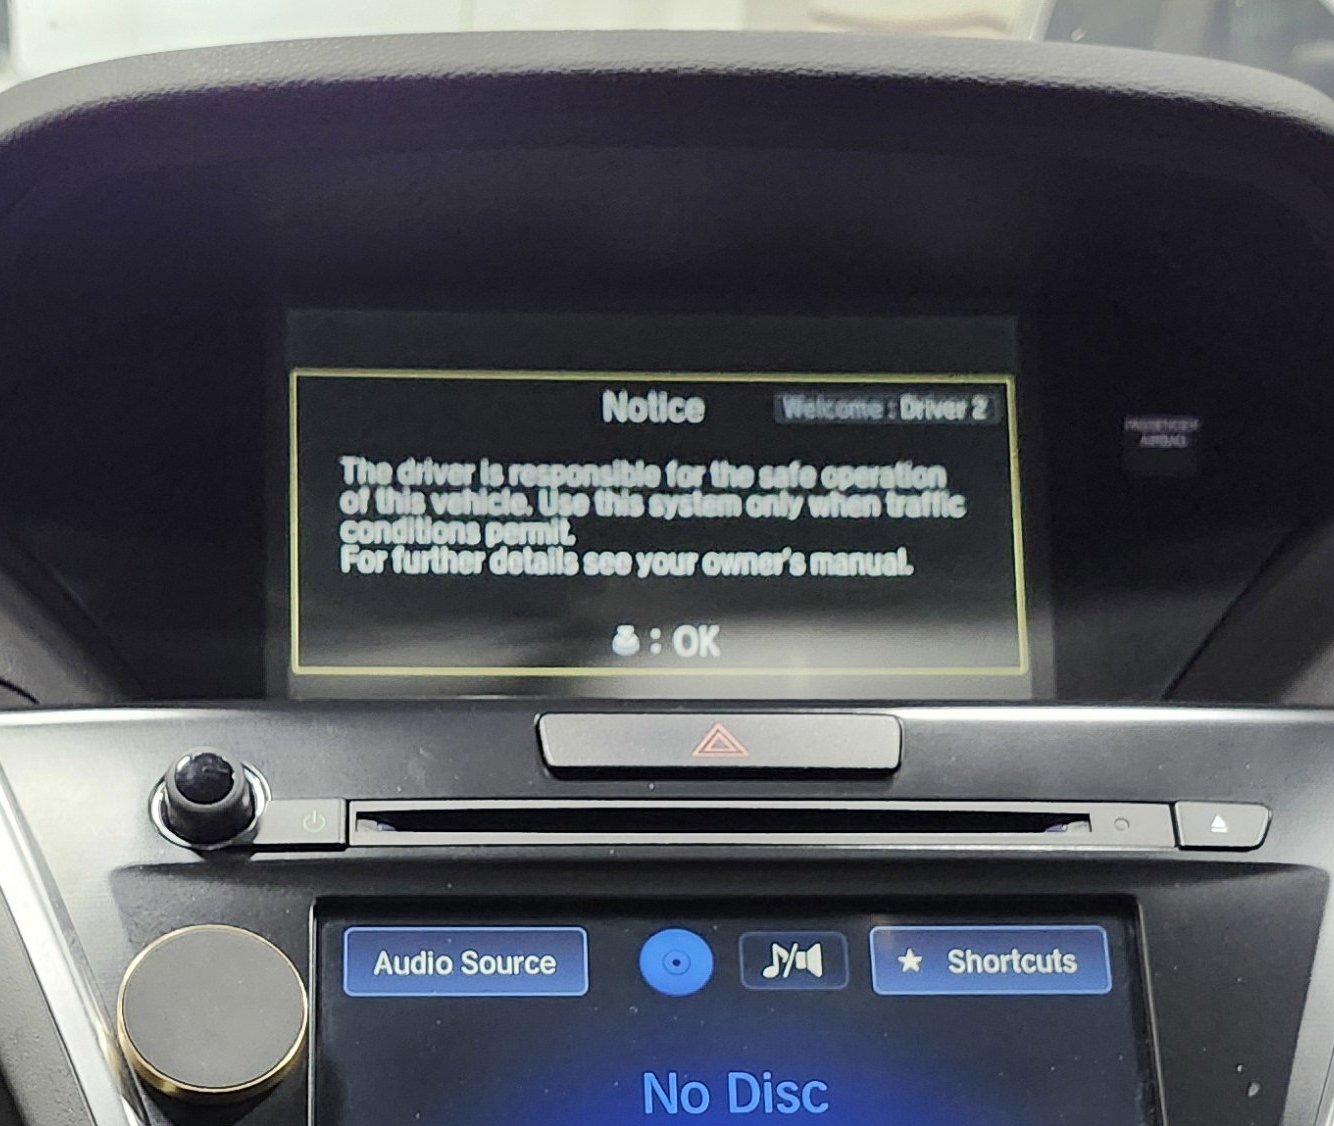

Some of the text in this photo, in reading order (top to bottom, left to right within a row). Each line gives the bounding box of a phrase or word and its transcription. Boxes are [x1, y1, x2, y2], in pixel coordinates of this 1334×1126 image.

[603, 389, 705, 423] Notice
[783, 394, 884, 420] Welcome
[900, 394, 967, 420] Driver
[972, 395, 988, 420] 2
[340, 456, 947, 491] The driver is responsible for the safe operation
[339, 486, 967, 520] of this vehicle. Use this system only when traffic
[340, 516, 576, 548] conditions permit.
[340, 544, 914, 578] For further details see your owner's manual.
[673, 625, 720, 657] OK
[373, 950, 557, 977] Audio Source
[947, 948, 1077, 976] Shortcuts
[643, 1071, 830, 1115] No Disc
